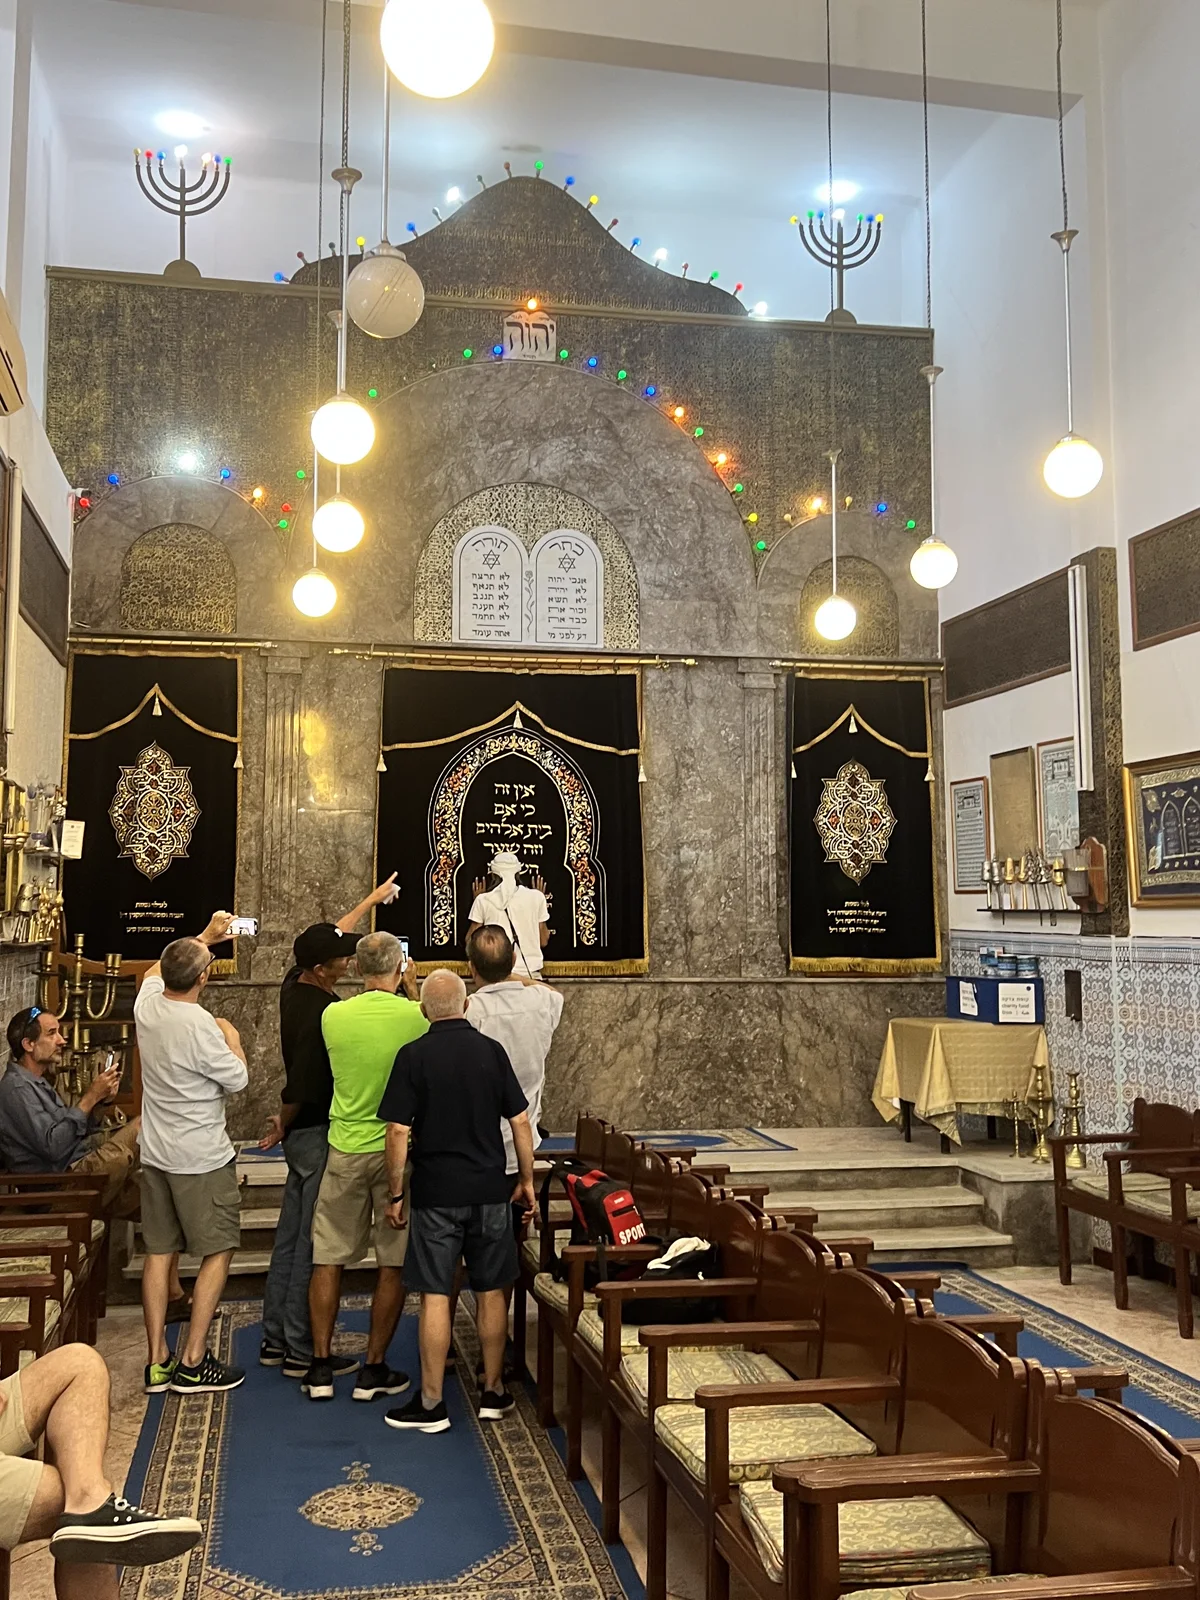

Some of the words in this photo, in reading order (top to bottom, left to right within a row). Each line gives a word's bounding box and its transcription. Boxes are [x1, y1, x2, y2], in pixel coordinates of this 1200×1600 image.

[506, 321, 554, 351] יהוה
[471, 537, 509, 552] תורה
[548, 541, 585, 556] כתר
[471, 572, 495, 580] תרצח
[499, 571, 510, 580] לא
[472, 582, 494, 592] תנאף
[498, 581, 509, 590] לא
[575, 585, 587, 594] לא
[498, 591, 509, 600] לא
[575, 595, 587, 604] לא
[498, 601, 509, 610] לא
[499, 611, 510, 620] לא
[471, 629, 491, 638] עומד
[548, 631, 556, 639] מי
[559, 630, 575, 639] לפני
[577, 633, 587, 641] דע
[494, 782, 511, 795] זה
[513, 783, 536, 801] אין
[493, 803, 517, 817] אם
[520, 804, 536, 817] כי
[476, 817, 524, 839] אלהים
[523, 824, 553, 840] בית
[483, 842, 520, 856] שער
[523, 843, 544, 856] וזה
[619, 1223, 646, 1245] SPORT
